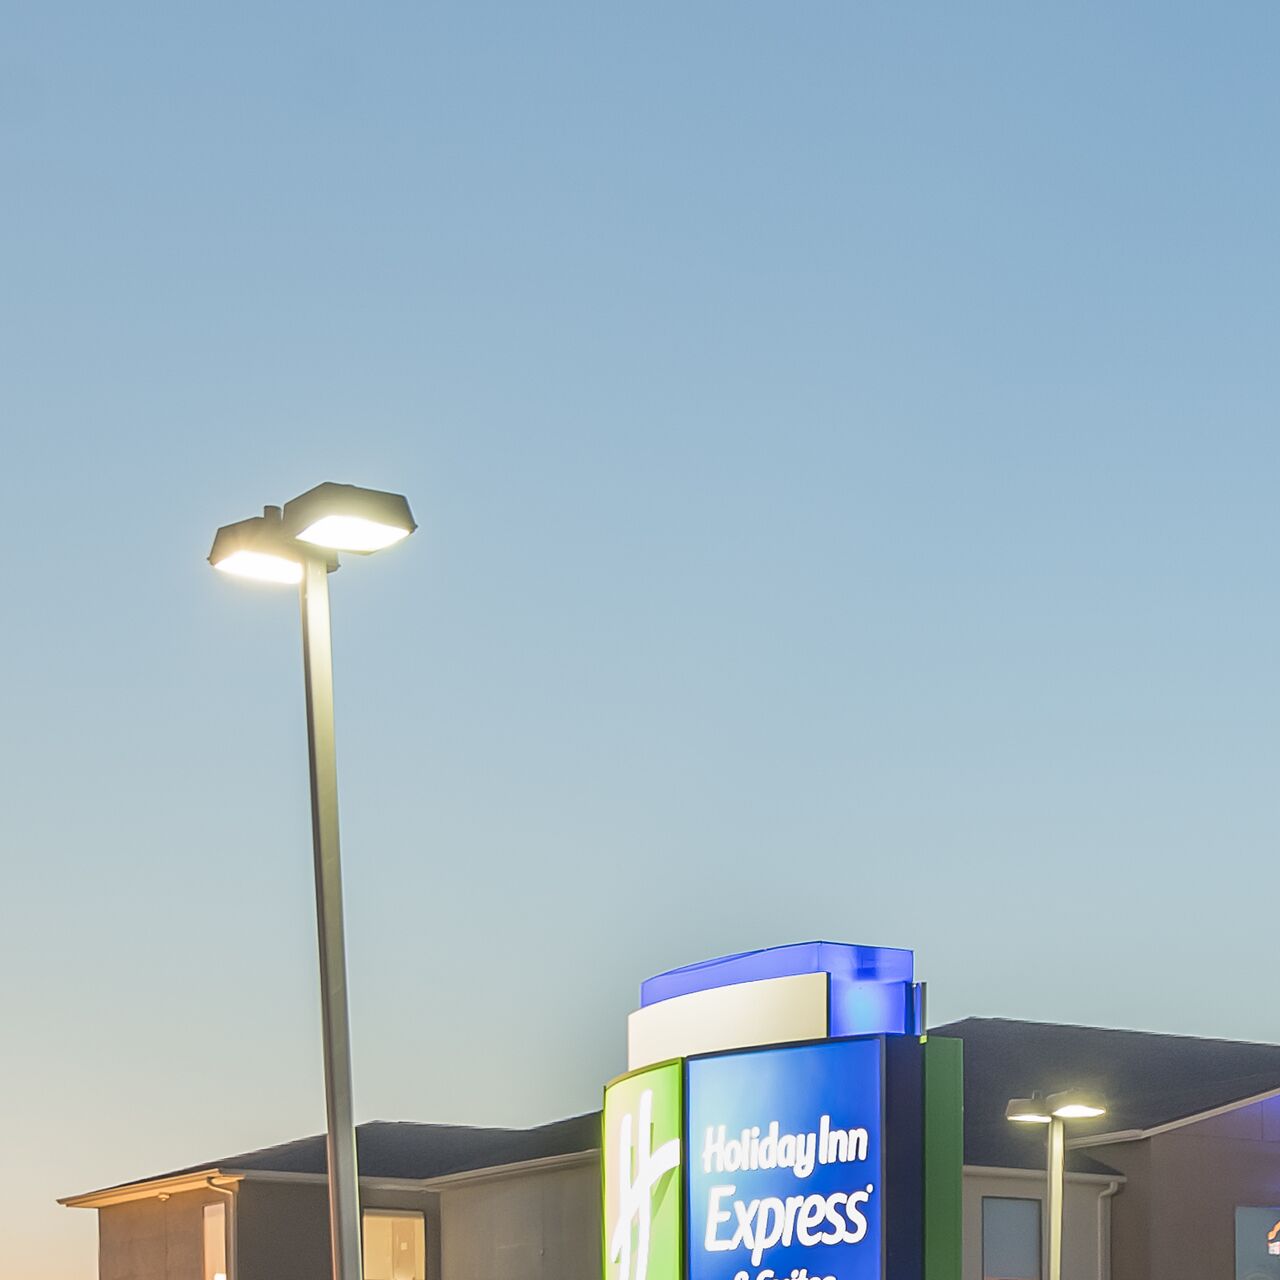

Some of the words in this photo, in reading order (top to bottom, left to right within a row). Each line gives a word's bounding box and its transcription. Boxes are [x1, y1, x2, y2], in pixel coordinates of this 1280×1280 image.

[701, 1120, 817, 1179] Holiday
[818, 1114, 869, 1165] Inn
[703, 1183, 870, 1267] Express
